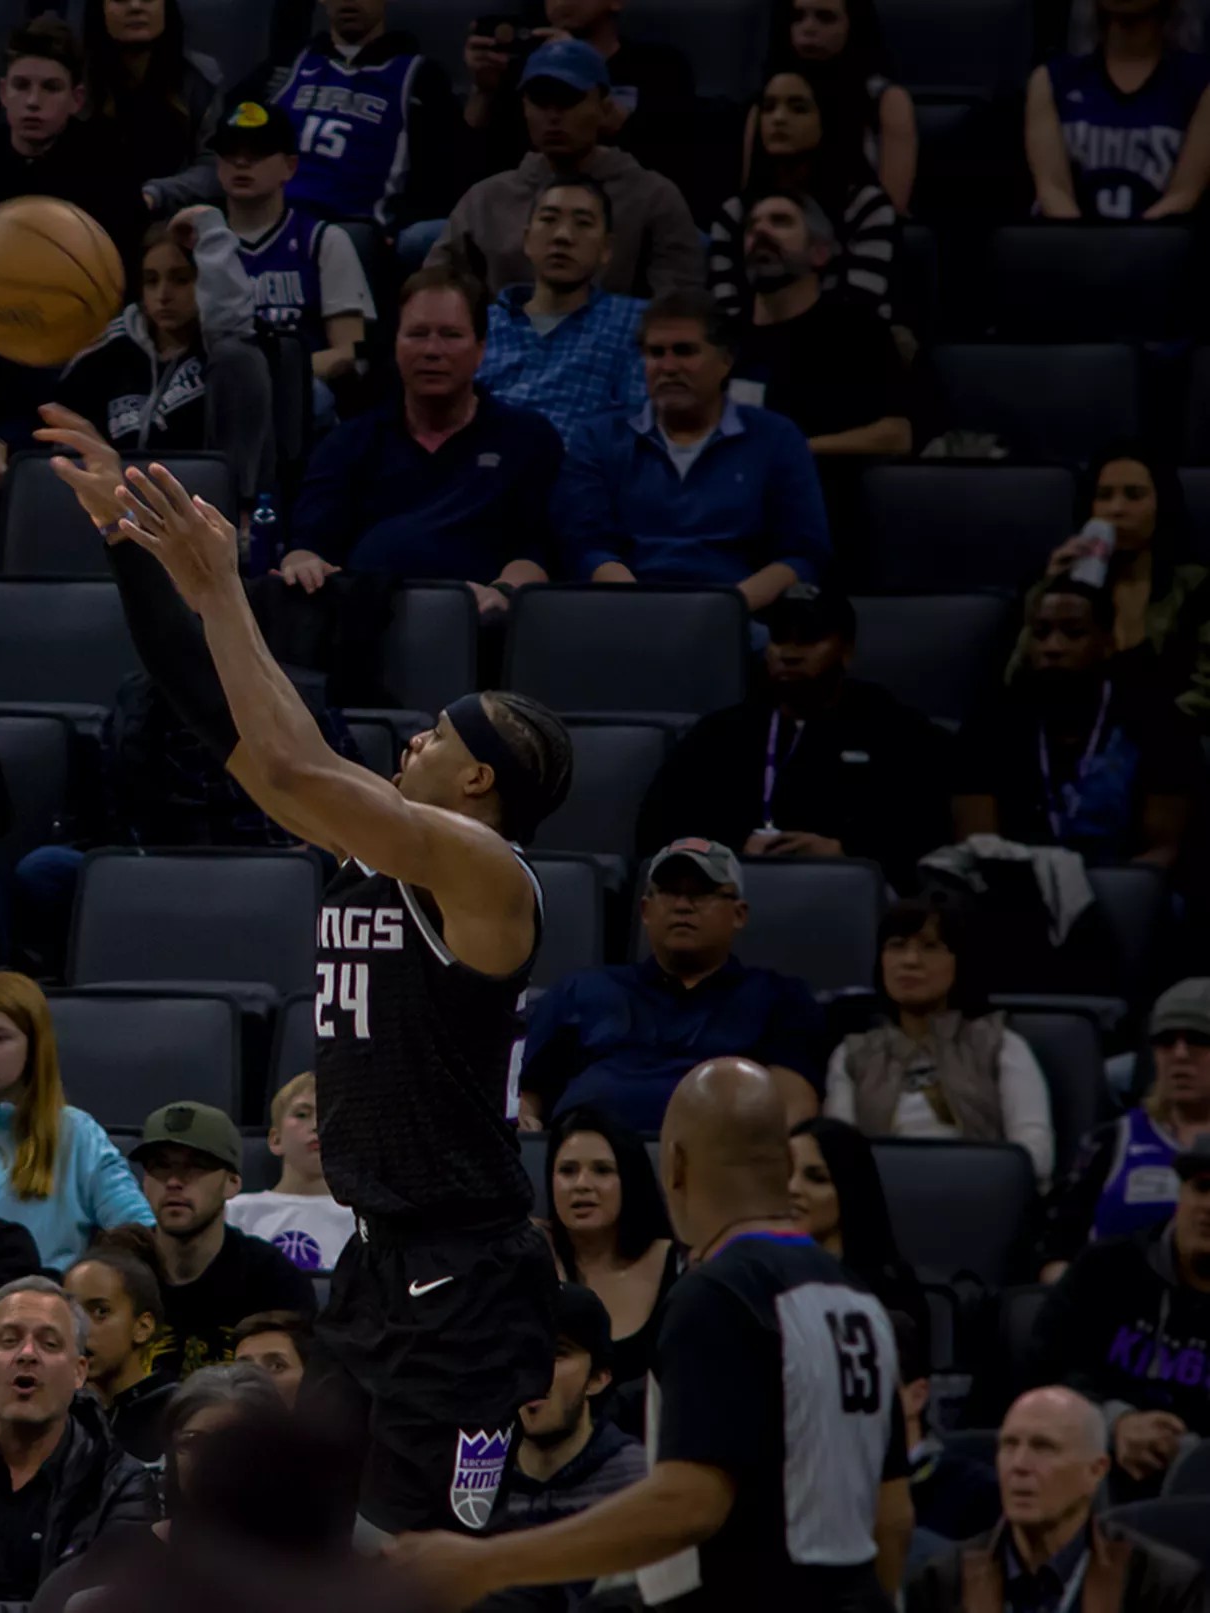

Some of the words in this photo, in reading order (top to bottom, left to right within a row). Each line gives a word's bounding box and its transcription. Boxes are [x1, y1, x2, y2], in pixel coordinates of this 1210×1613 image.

[298, 114, 355, 160] 15
[316, 905, 405, 950] NGS
[314, 962, 371, 1039] 24
